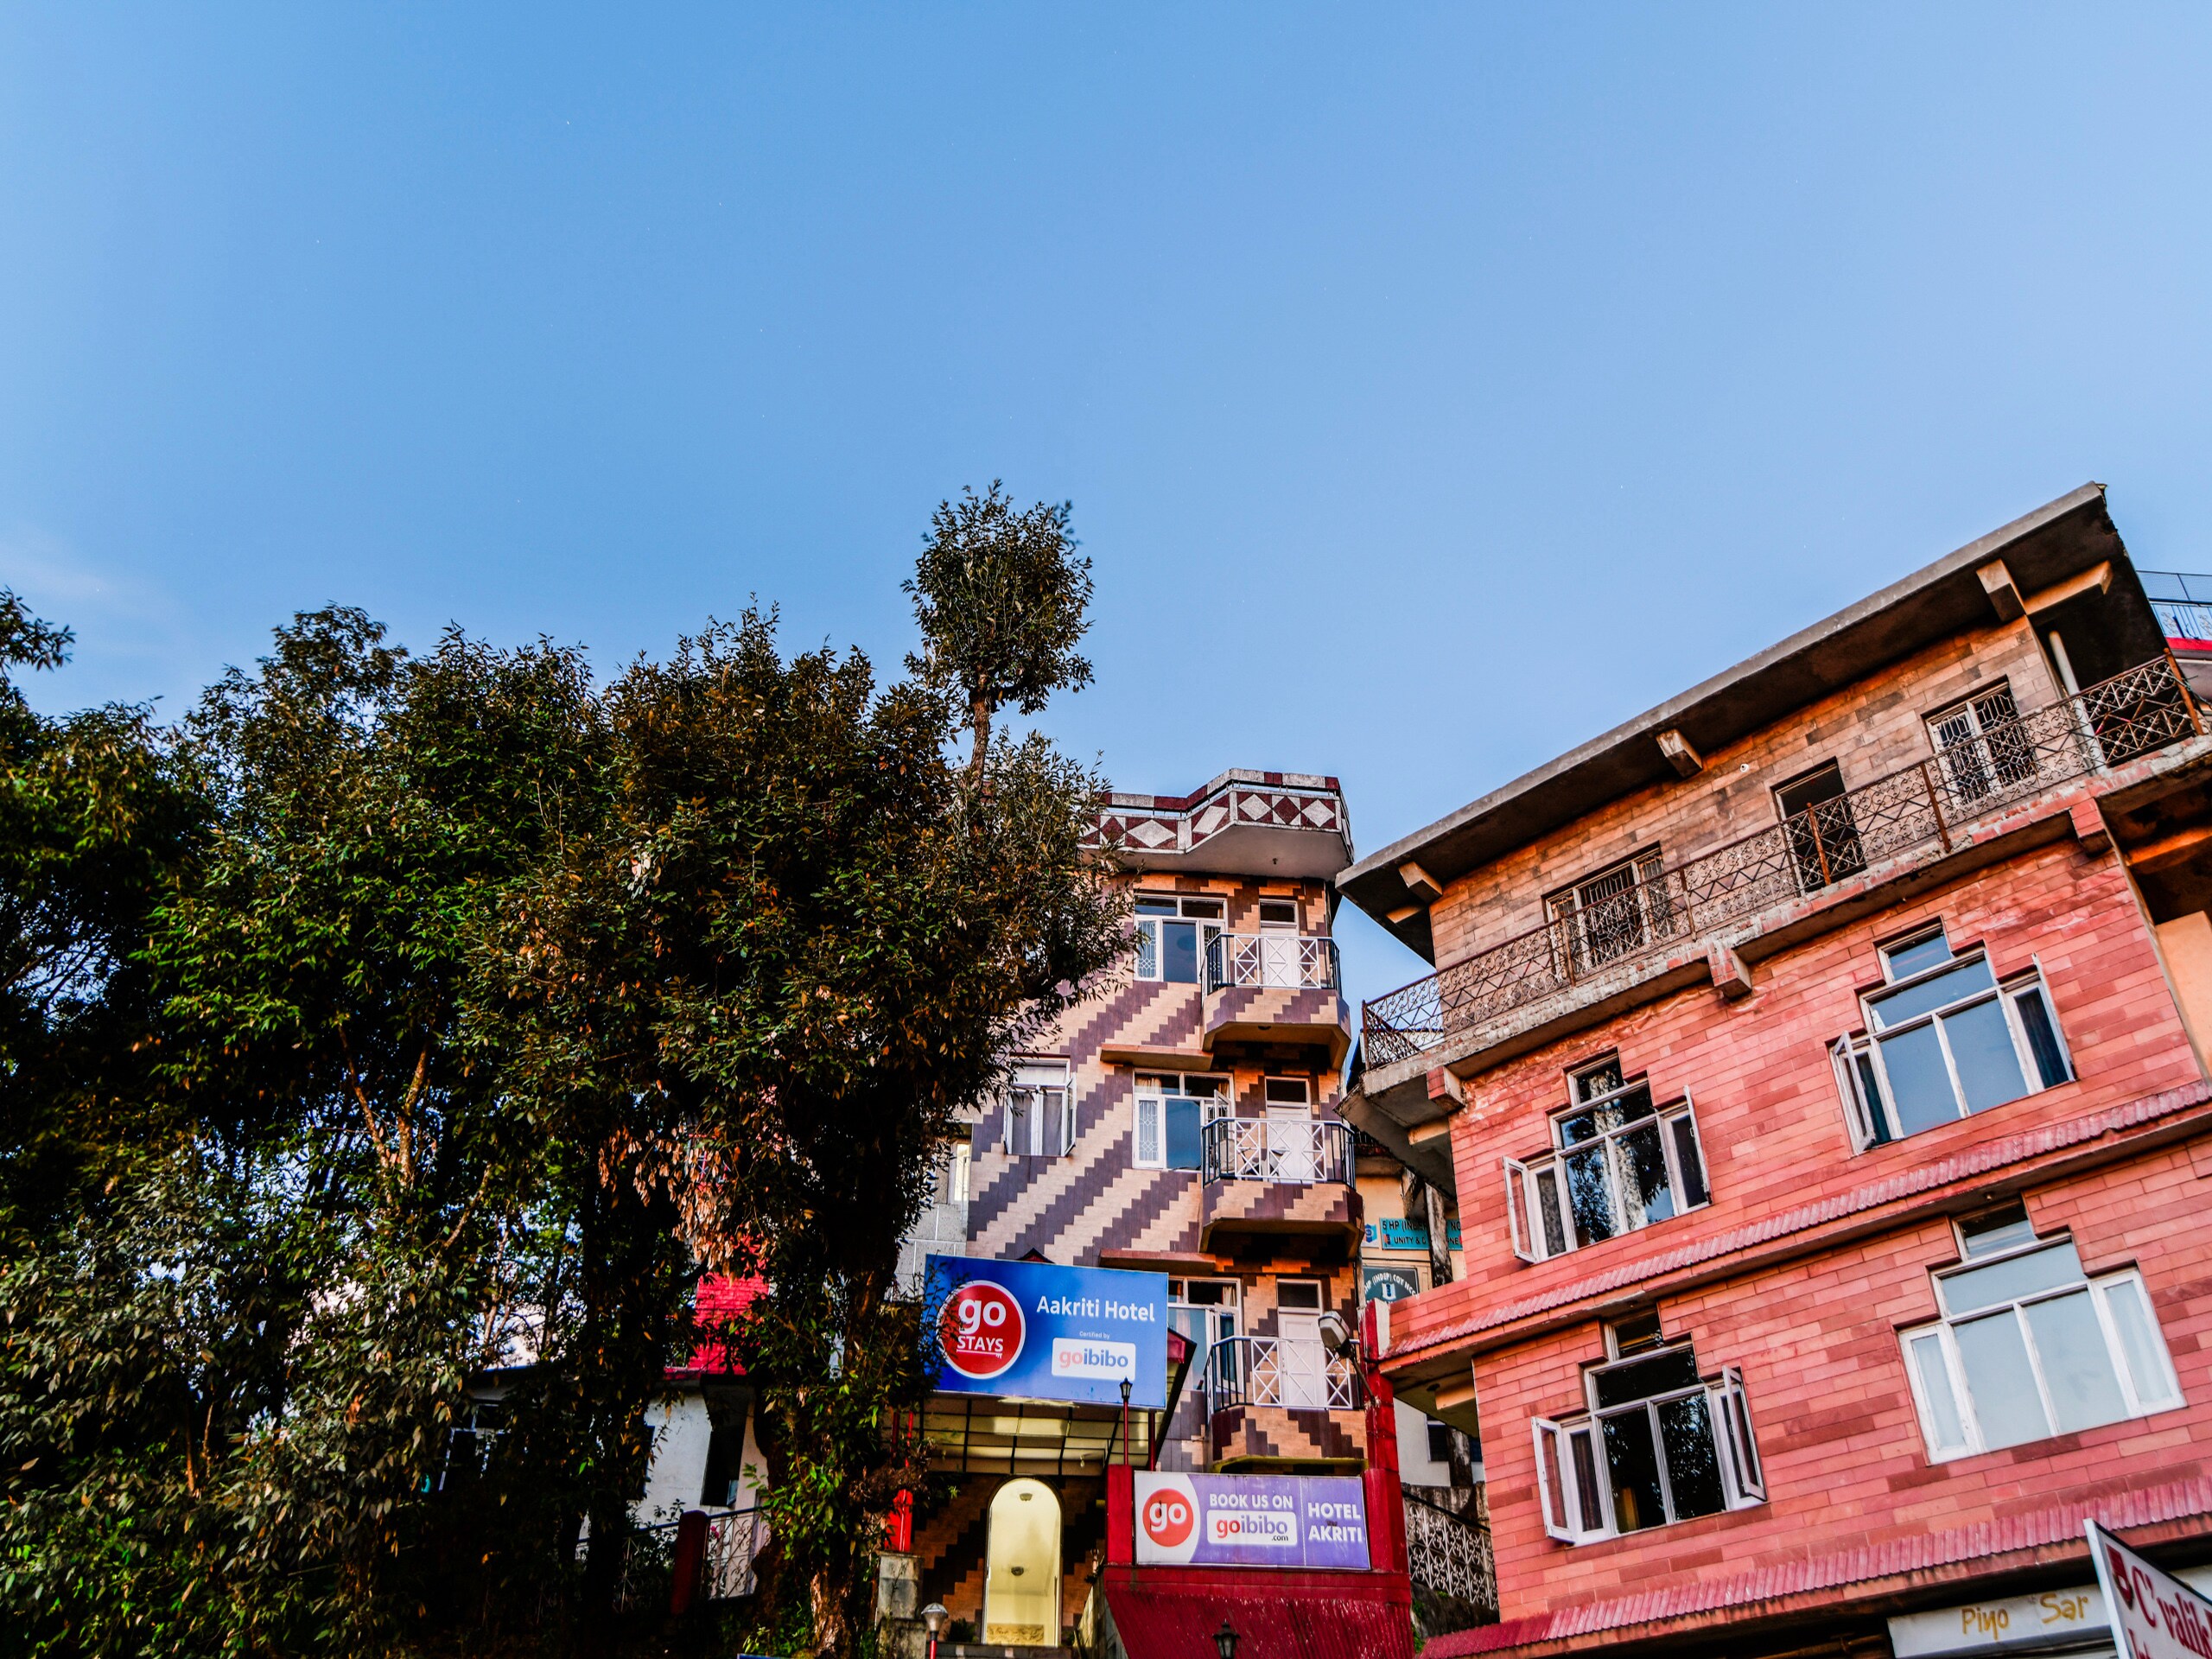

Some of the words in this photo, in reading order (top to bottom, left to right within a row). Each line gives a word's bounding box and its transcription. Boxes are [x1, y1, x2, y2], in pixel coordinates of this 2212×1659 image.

[1389, 1221, 1399, 1230] HP
[1393, 1274, 1404, 1286] COY
[958, 1298, 1007, 1333] go
[1037, 1296, 1099, 1318] Aakriti
[1104, 1301, 1155, 1322] Hotel
[957, 1336, 1004, 1352] STAYS
[1059, 1349, 1128, 1369] goibibo
[1210, 1493, 1248, 1507] BOOK
[1252, 1495, 1268, 1507] US
[1272, 1496, 1293, 1509] ON
[1149, 1501, 1187, 1532] go
[1307, 1502, 1361, 1519] HOTEL
[1216, 1515, 1287, 1538] goibibo
[1308, 1525, 1363, 1542] AKRITI
[1961, 1606, 2009, 1641] Piyo
[2040, 1592, 2088, 1624] Sar
